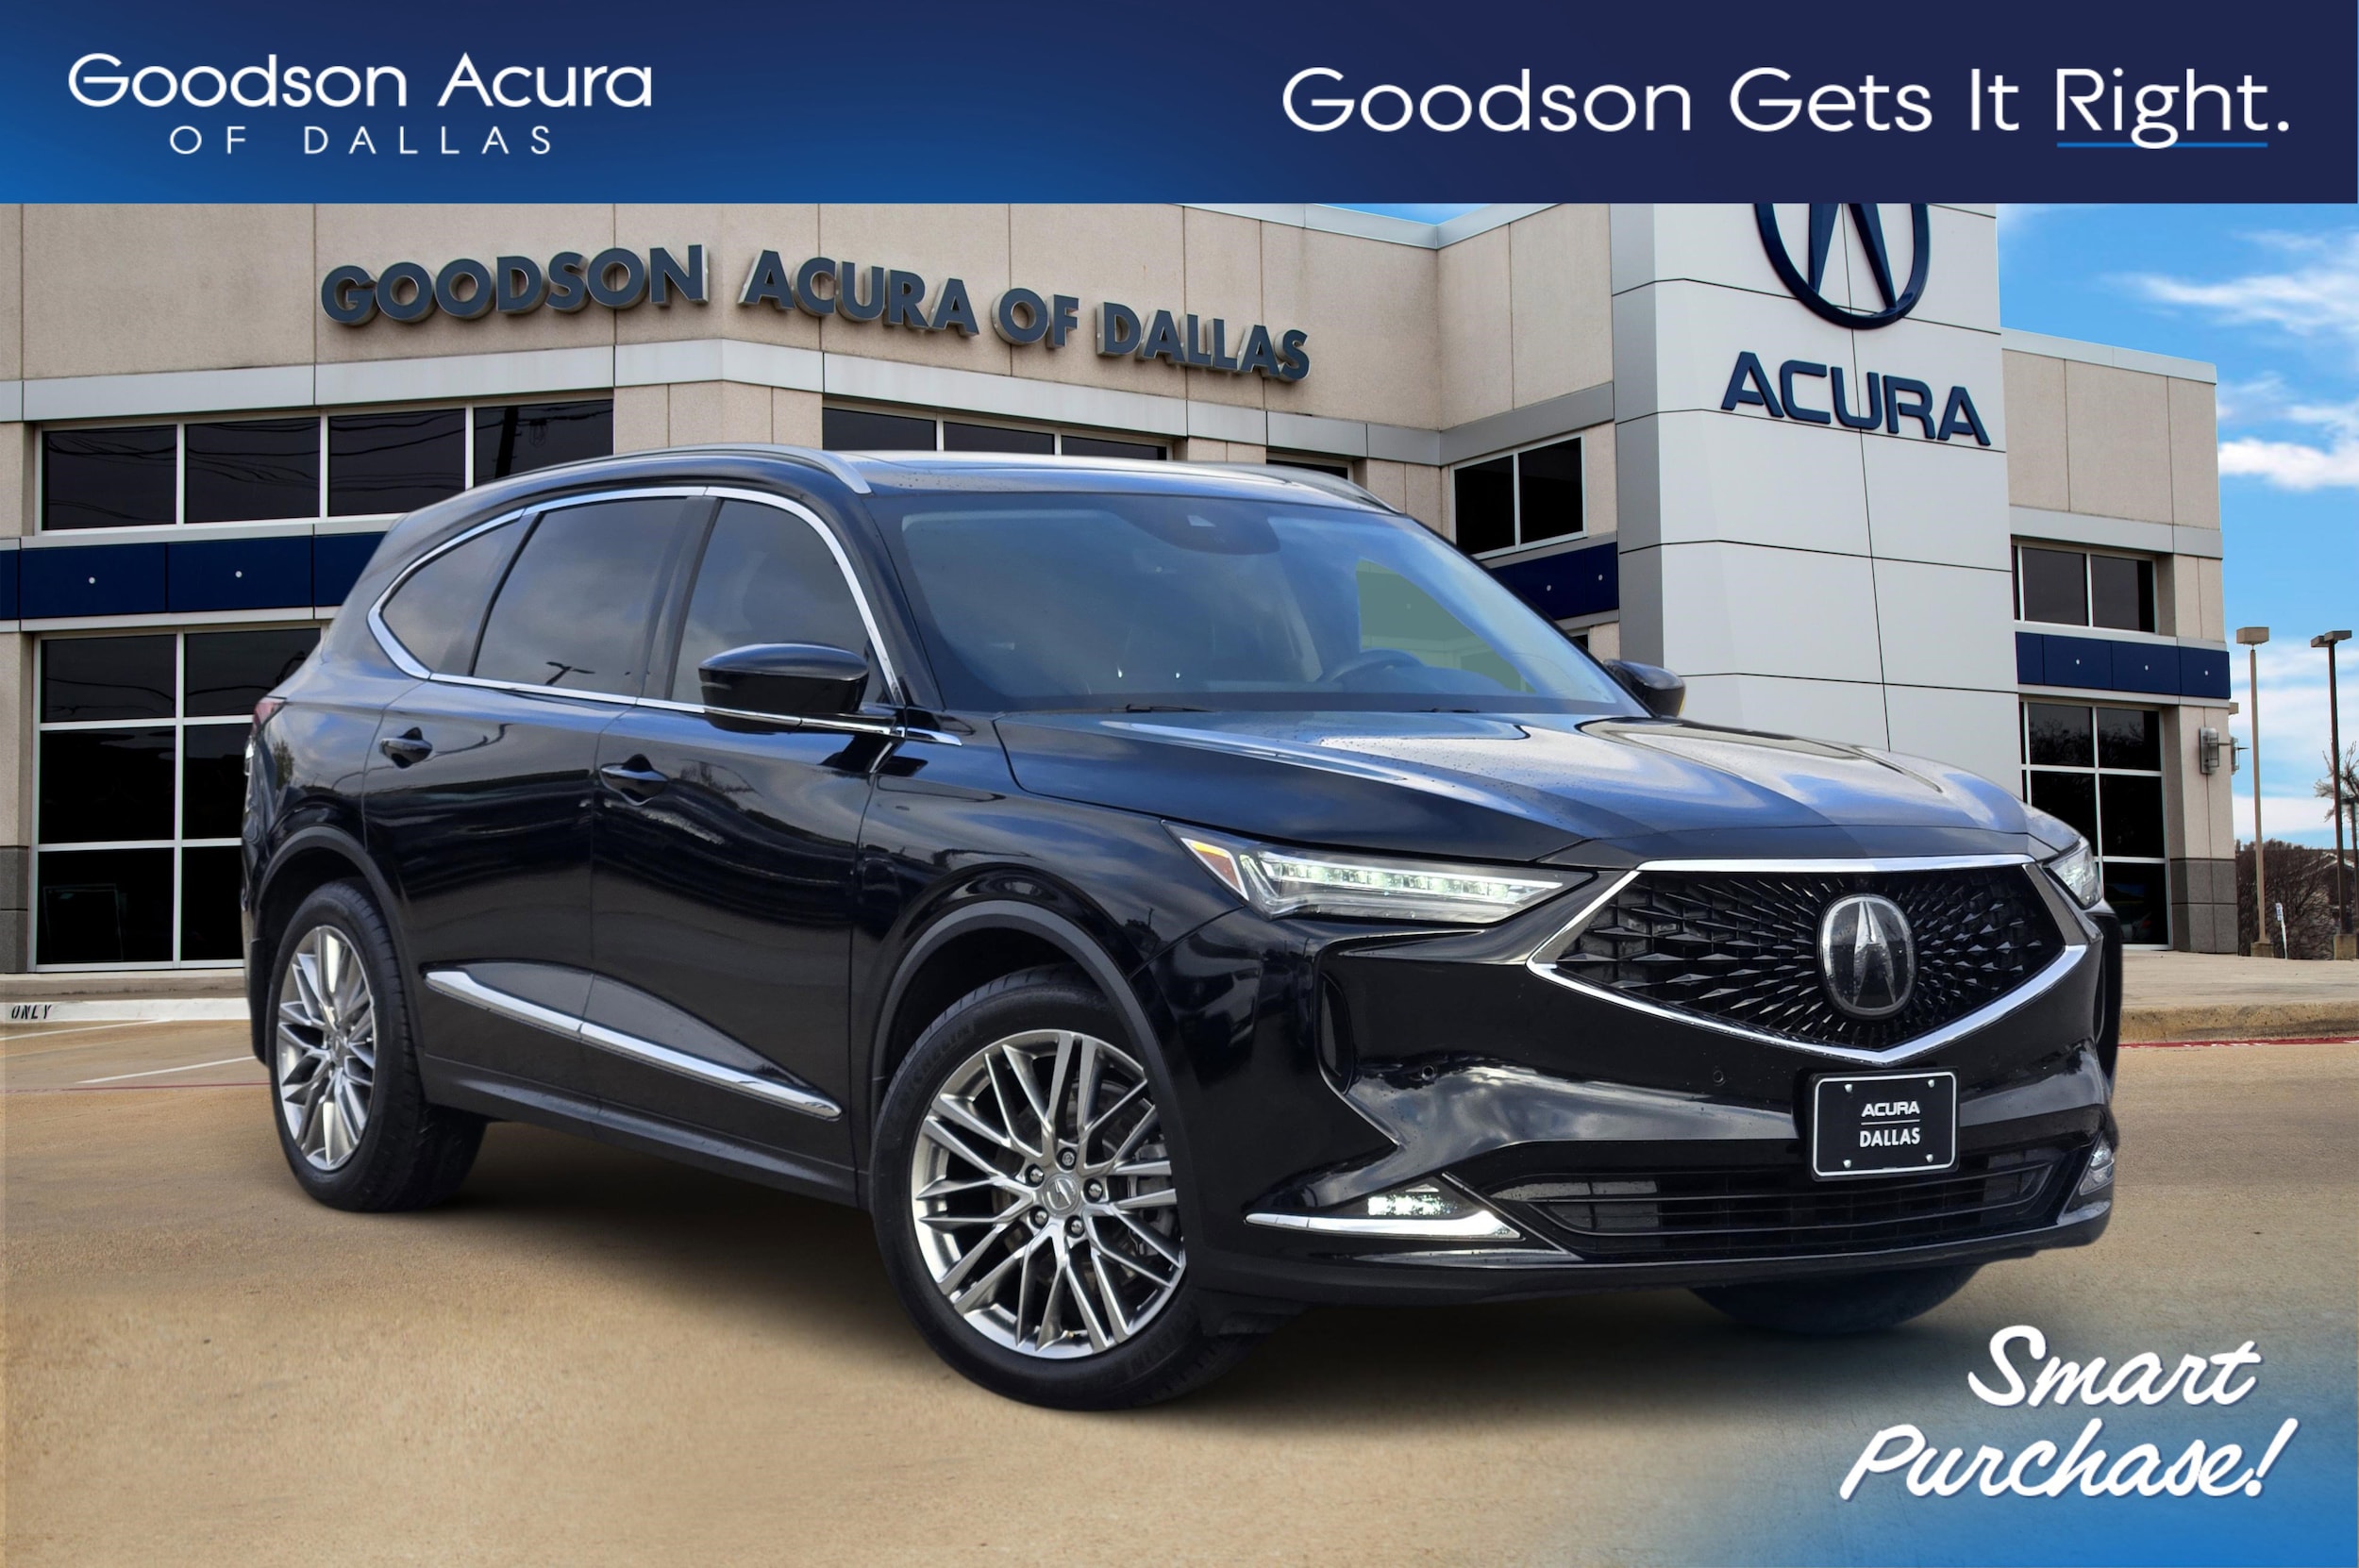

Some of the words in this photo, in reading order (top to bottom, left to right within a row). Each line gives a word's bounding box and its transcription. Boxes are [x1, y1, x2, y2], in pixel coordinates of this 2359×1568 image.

[320, 243, 710, 326] GOODSON
[738, 248, 979, 338] ACURA
[991, 287, 1079, 348] OF
[1096, 301, 1311, 382] DALLAS
[1720, 351, 1991, 446] ACURA
[10, 1004, 52, 1020] ONLY
[1861, 1100, 1921, 1118] ACURA
[1859, 1126, 1921, 1148] DALLAS
